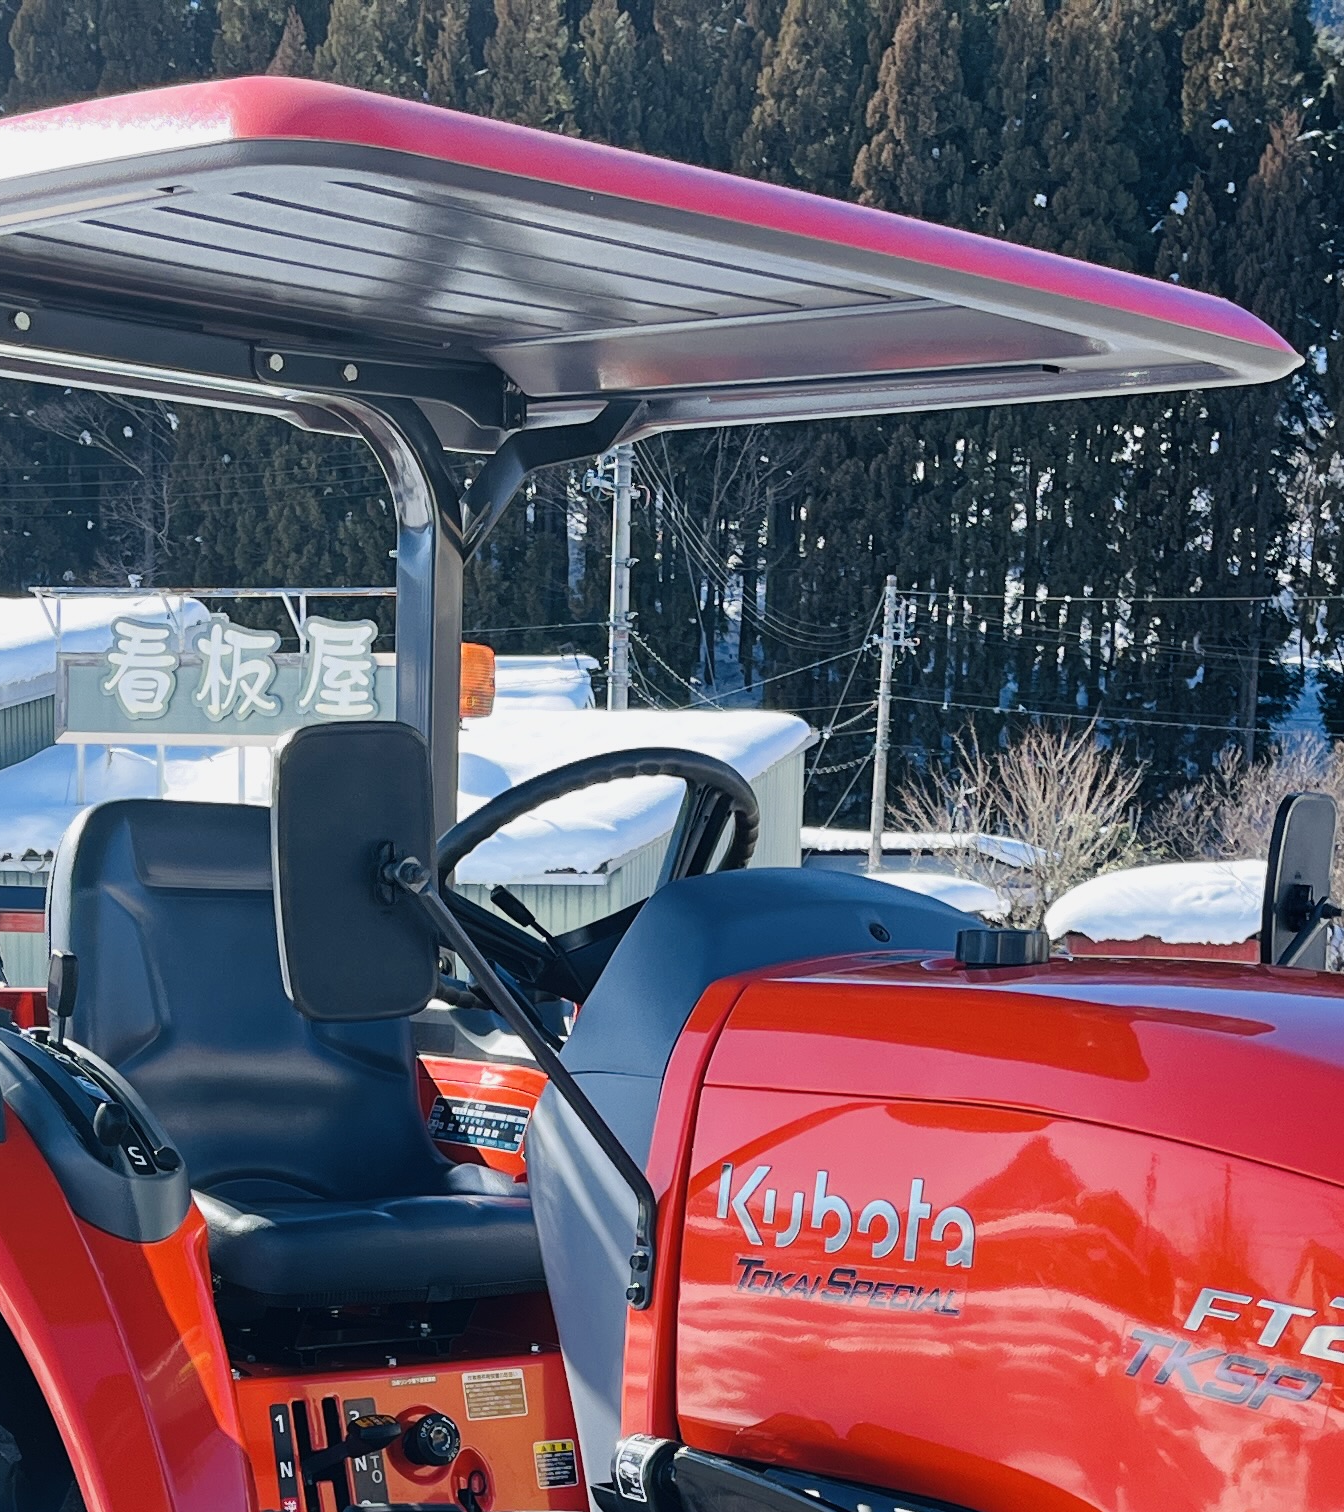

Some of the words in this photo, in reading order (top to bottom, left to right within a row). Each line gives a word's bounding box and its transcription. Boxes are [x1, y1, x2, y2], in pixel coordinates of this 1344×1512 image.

[104, 621, 375, 716] 看板屋
[716, 1162, 976, 1269] Kubota
[1125, 1328, 1323, 1410] TKSP
[274, 1414, 285, 1433] 1
[279, 1461, 294, 1478] N
[355, 1455, 367, 1472] N
[369, 1455, 383, 1484] TO
